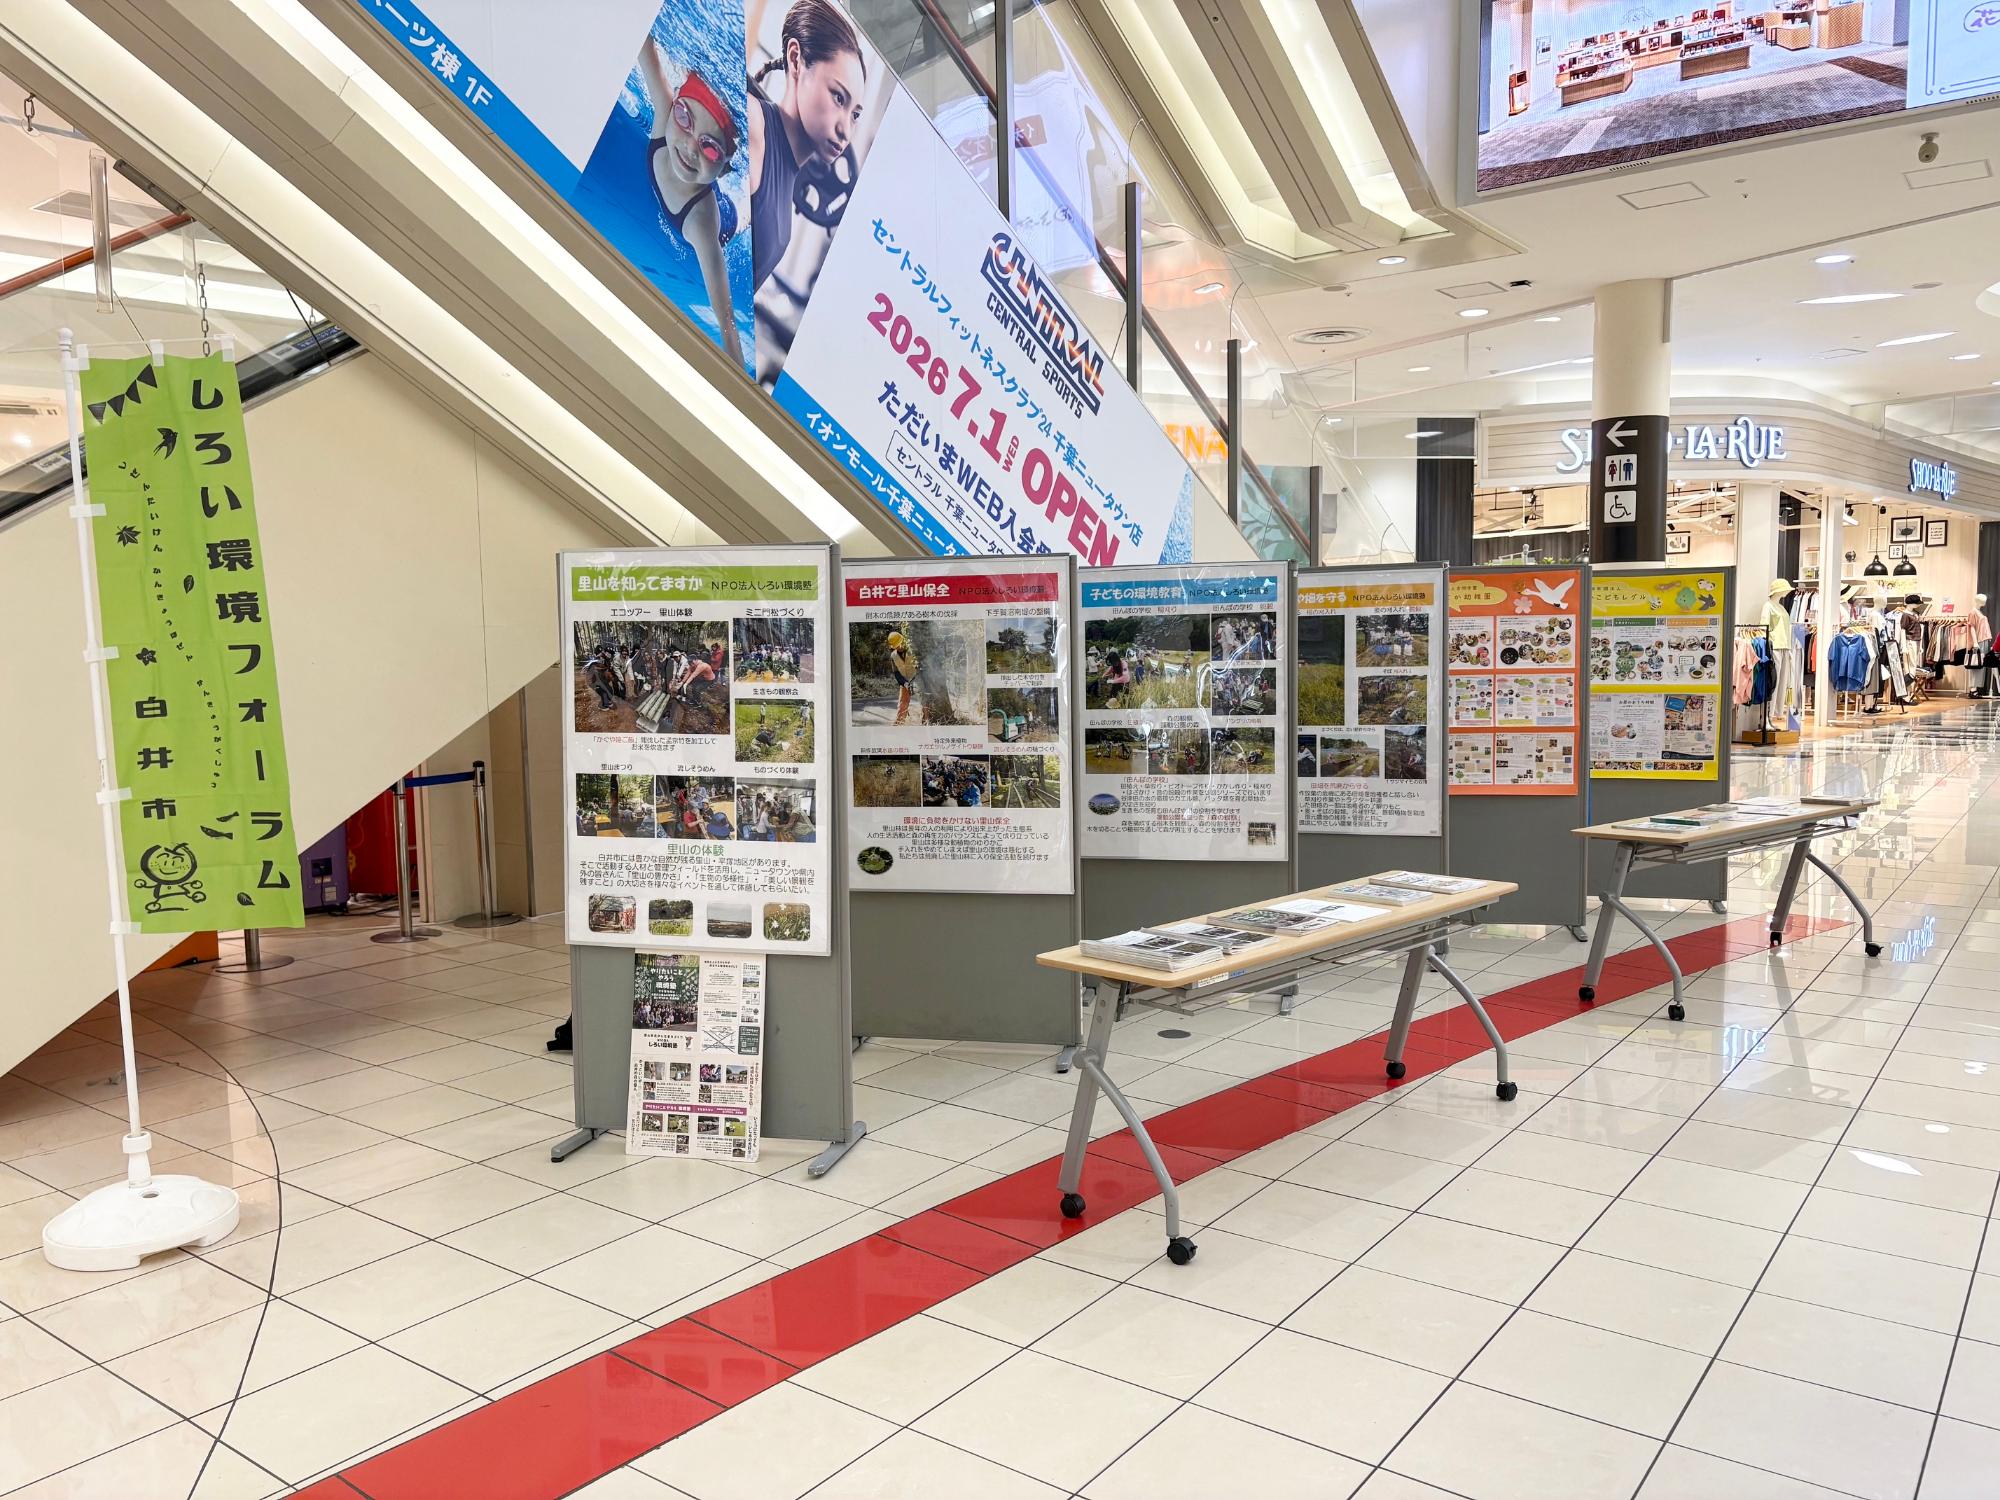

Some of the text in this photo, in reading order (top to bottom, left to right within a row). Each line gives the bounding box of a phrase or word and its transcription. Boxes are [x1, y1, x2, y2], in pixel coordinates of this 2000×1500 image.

[374, 0, 493, 106] ーツ棟 1F
[980, 232, 1105, 417] CENTRAL
[872, 217, 1052, 439] セントラルフィットネスクラブ24
[1053, 430, 1144, 548] 千葉ニュータウン店
[986, 294, 1084, 420] CENTRAL SPORTS
[866, 292, 1121, 566] 2026 7.1 WED OPEN
[806, 411, 968, 556] イオンモール千葉ニュータ
[896, 446, 942, 498] セントラル
[577, 575, 813, 593] 里山を知ってますか NPO法人しろい環境塾
[859, 583, 950, 599] 白井で里山保全
[1090, 586, 1183, 601] 子どもの環境教育
[192, 379, 291, 889] しろい環境フォーラム
[610, 607, 693, 618] エコツアー 里山体験
[745, 606, 805, 618] ミニ門松づくり
[135, 696, 177, 820] 白井市
[600, 763, 633, 772] 里山まつり
[753, 766, 799, 775] ものづくり体験
[667, 843, 725, 857] 里山の体験
